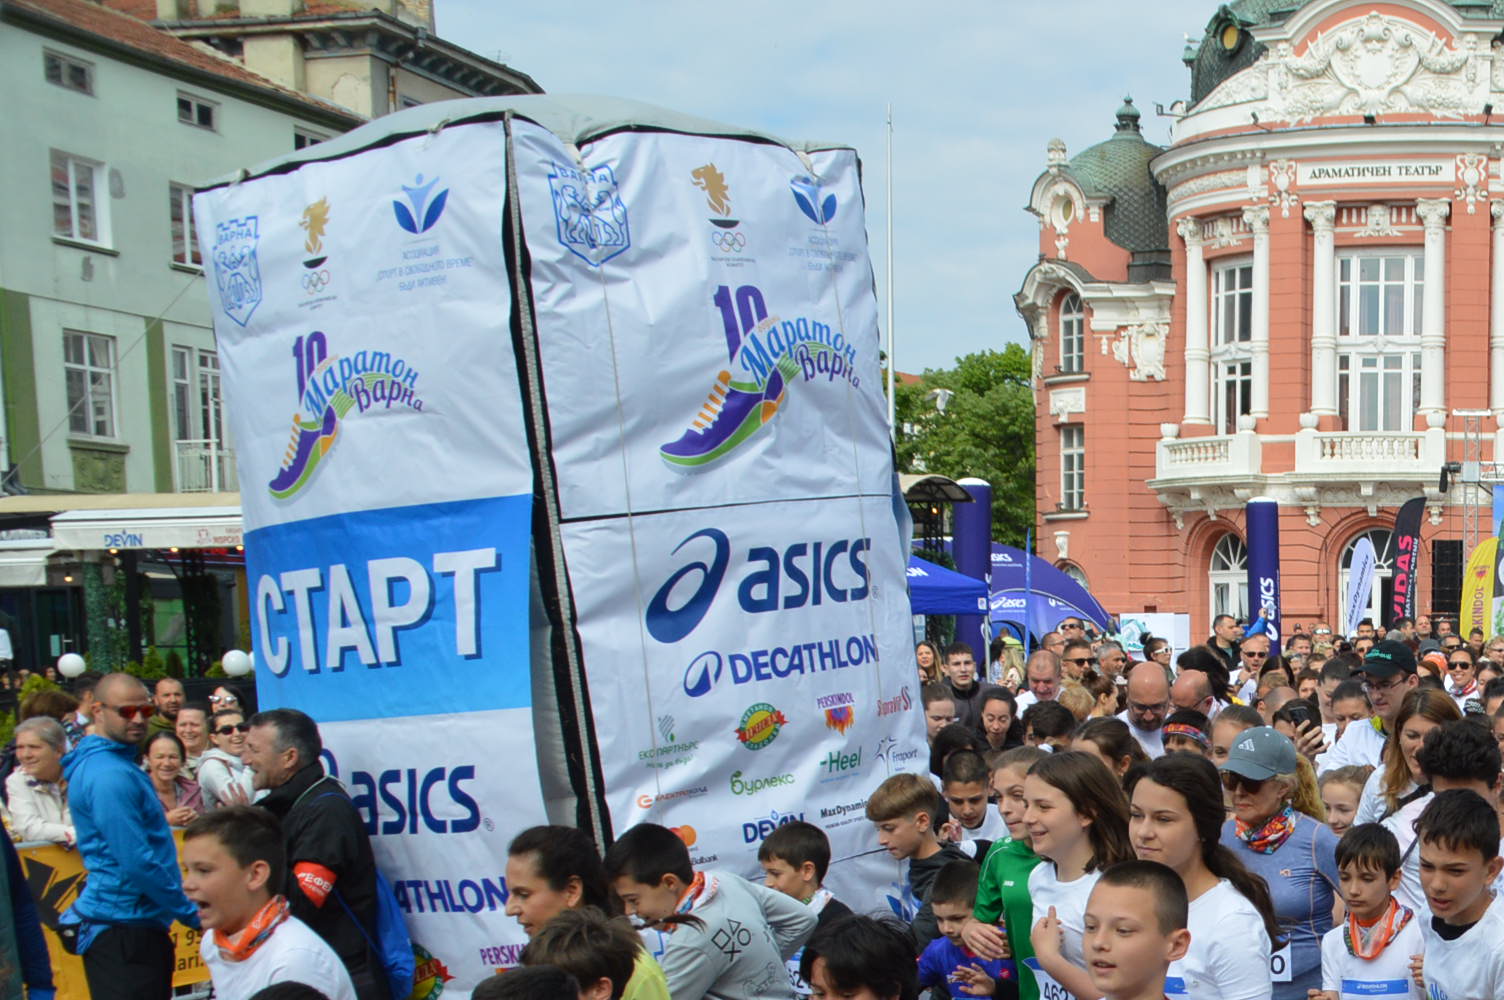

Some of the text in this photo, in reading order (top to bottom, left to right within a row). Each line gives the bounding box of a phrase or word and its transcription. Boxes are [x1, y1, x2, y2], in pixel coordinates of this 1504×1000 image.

[1309, 165, 1443, 180] ДРАМАТИЧЕН ТЕАТЪР
[740, 316, 856, 387] Маратон
[794, 344, 861, 389] Варна
[305, 349, 420, 424] Маратон
[349, 373, 424, 413] Варна
[104, 533, 143, 547] DEVIN
[1393, 535, 1412, 622] VIDAS
[256, 547, 497, 677] СТАРТ
[728, 634, 880, 685] DECATHLON
[816, 692, 855, 709] PERSKINDOL
[394, 877, 509, 914] ATHLON
